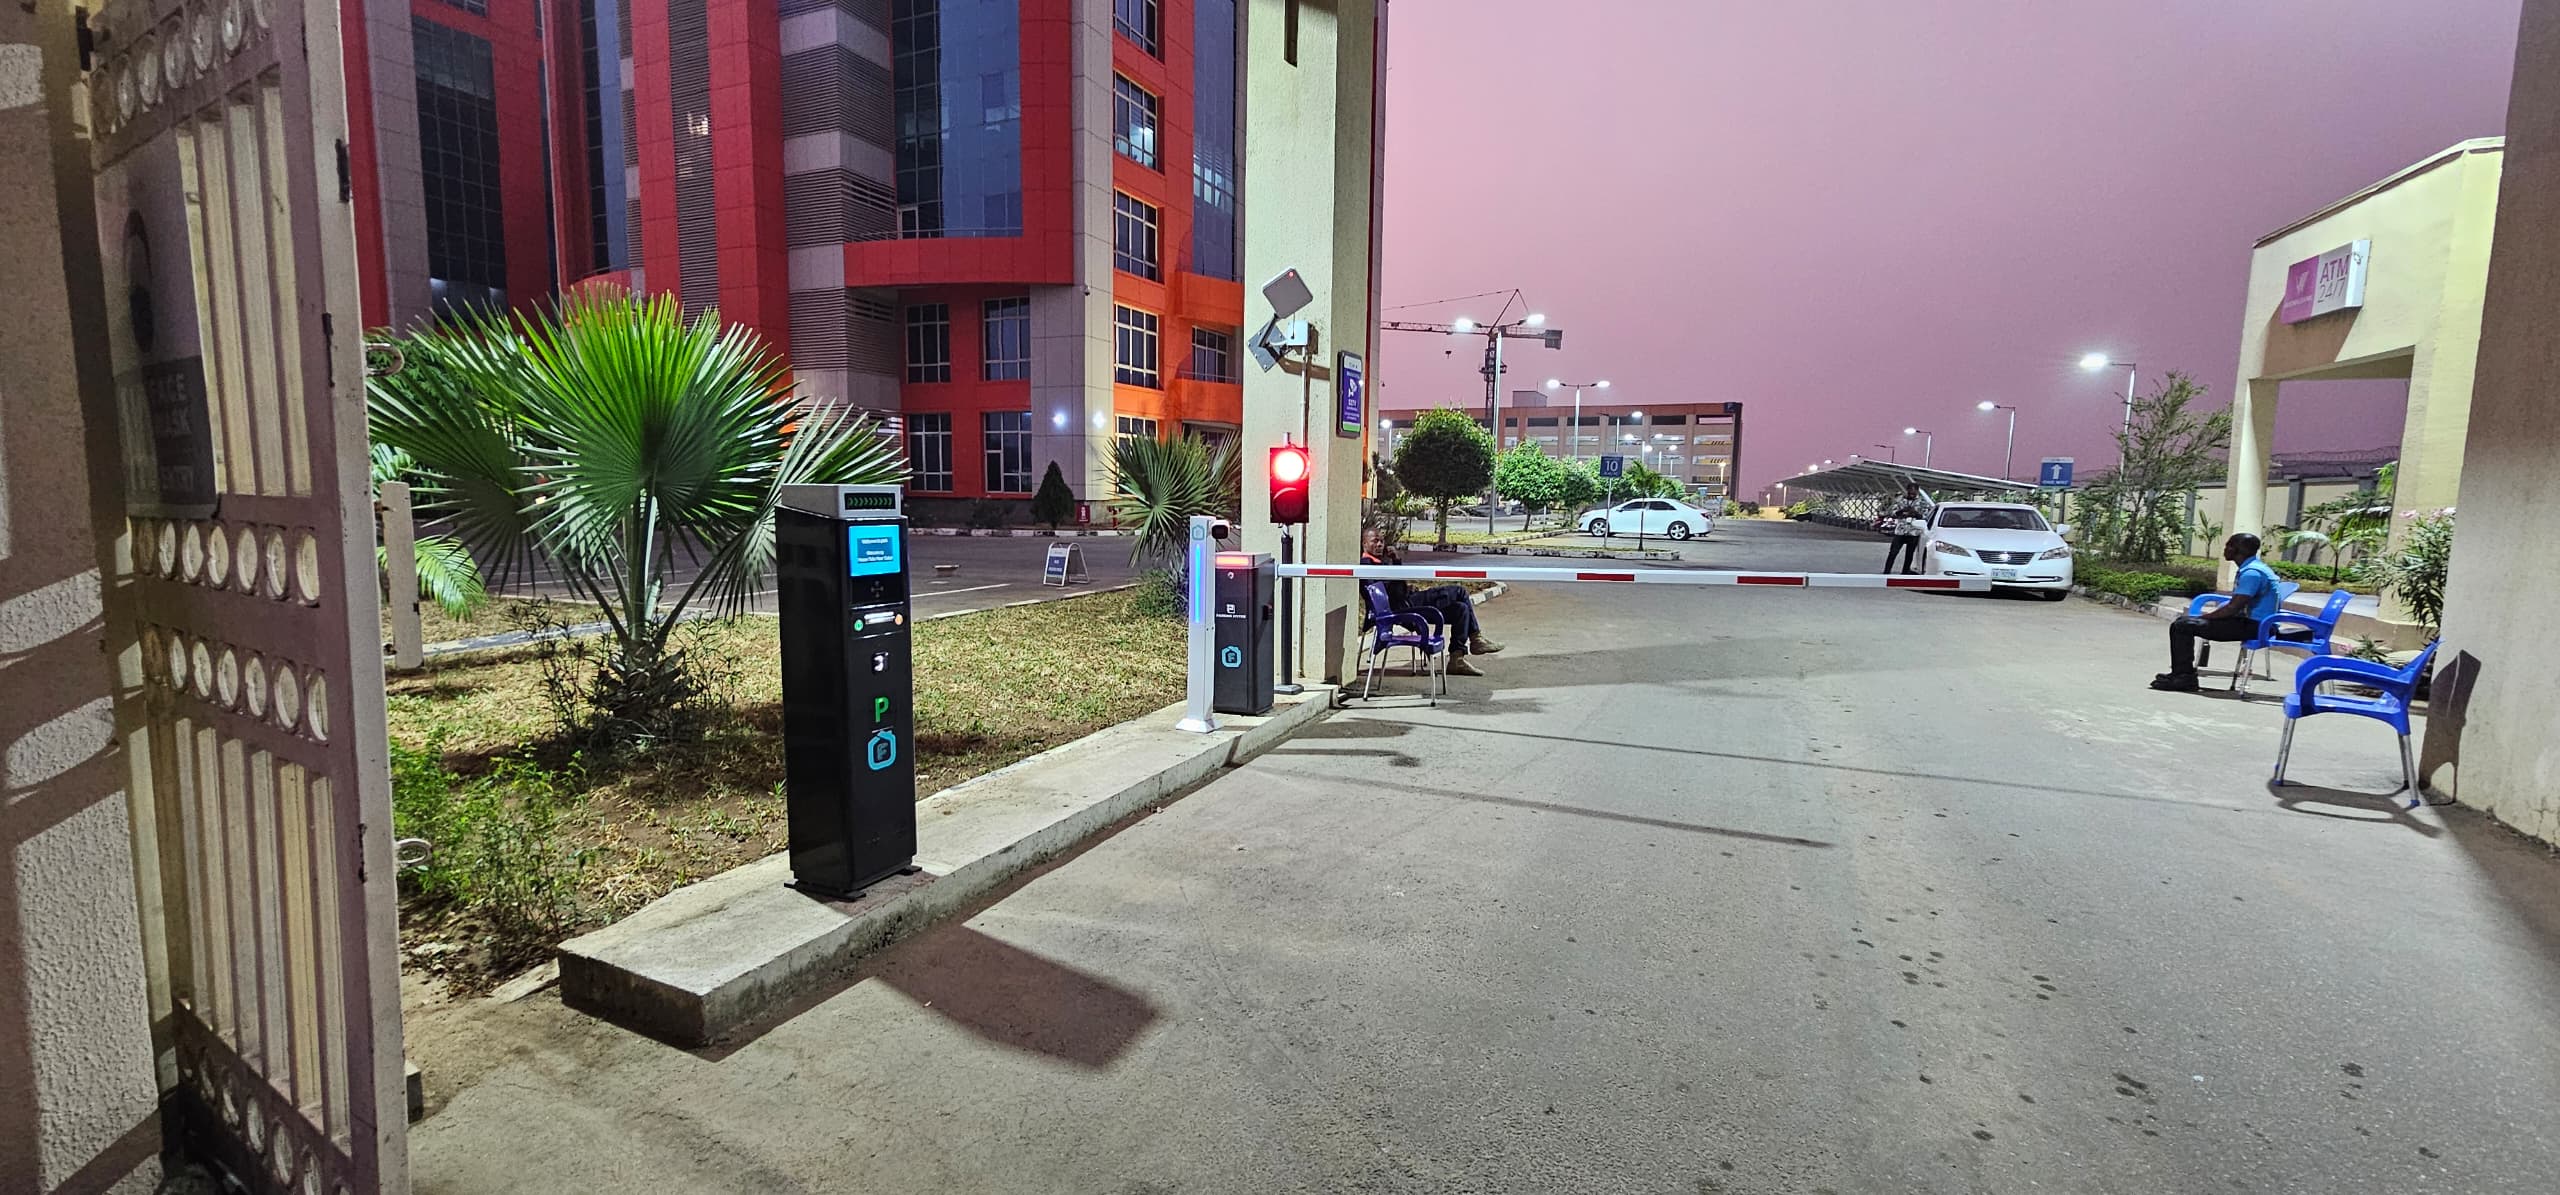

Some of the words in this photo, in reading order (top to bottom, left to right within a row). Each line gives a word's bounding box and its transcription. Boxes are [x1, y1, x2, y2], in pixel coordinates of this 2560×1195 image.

[2319, 254, 2351, 284] ATM
[2317, 277, 2346, 303] 24/7
[1606, 461, 1618, 472] 10
[874, 696, 889, 722] P
